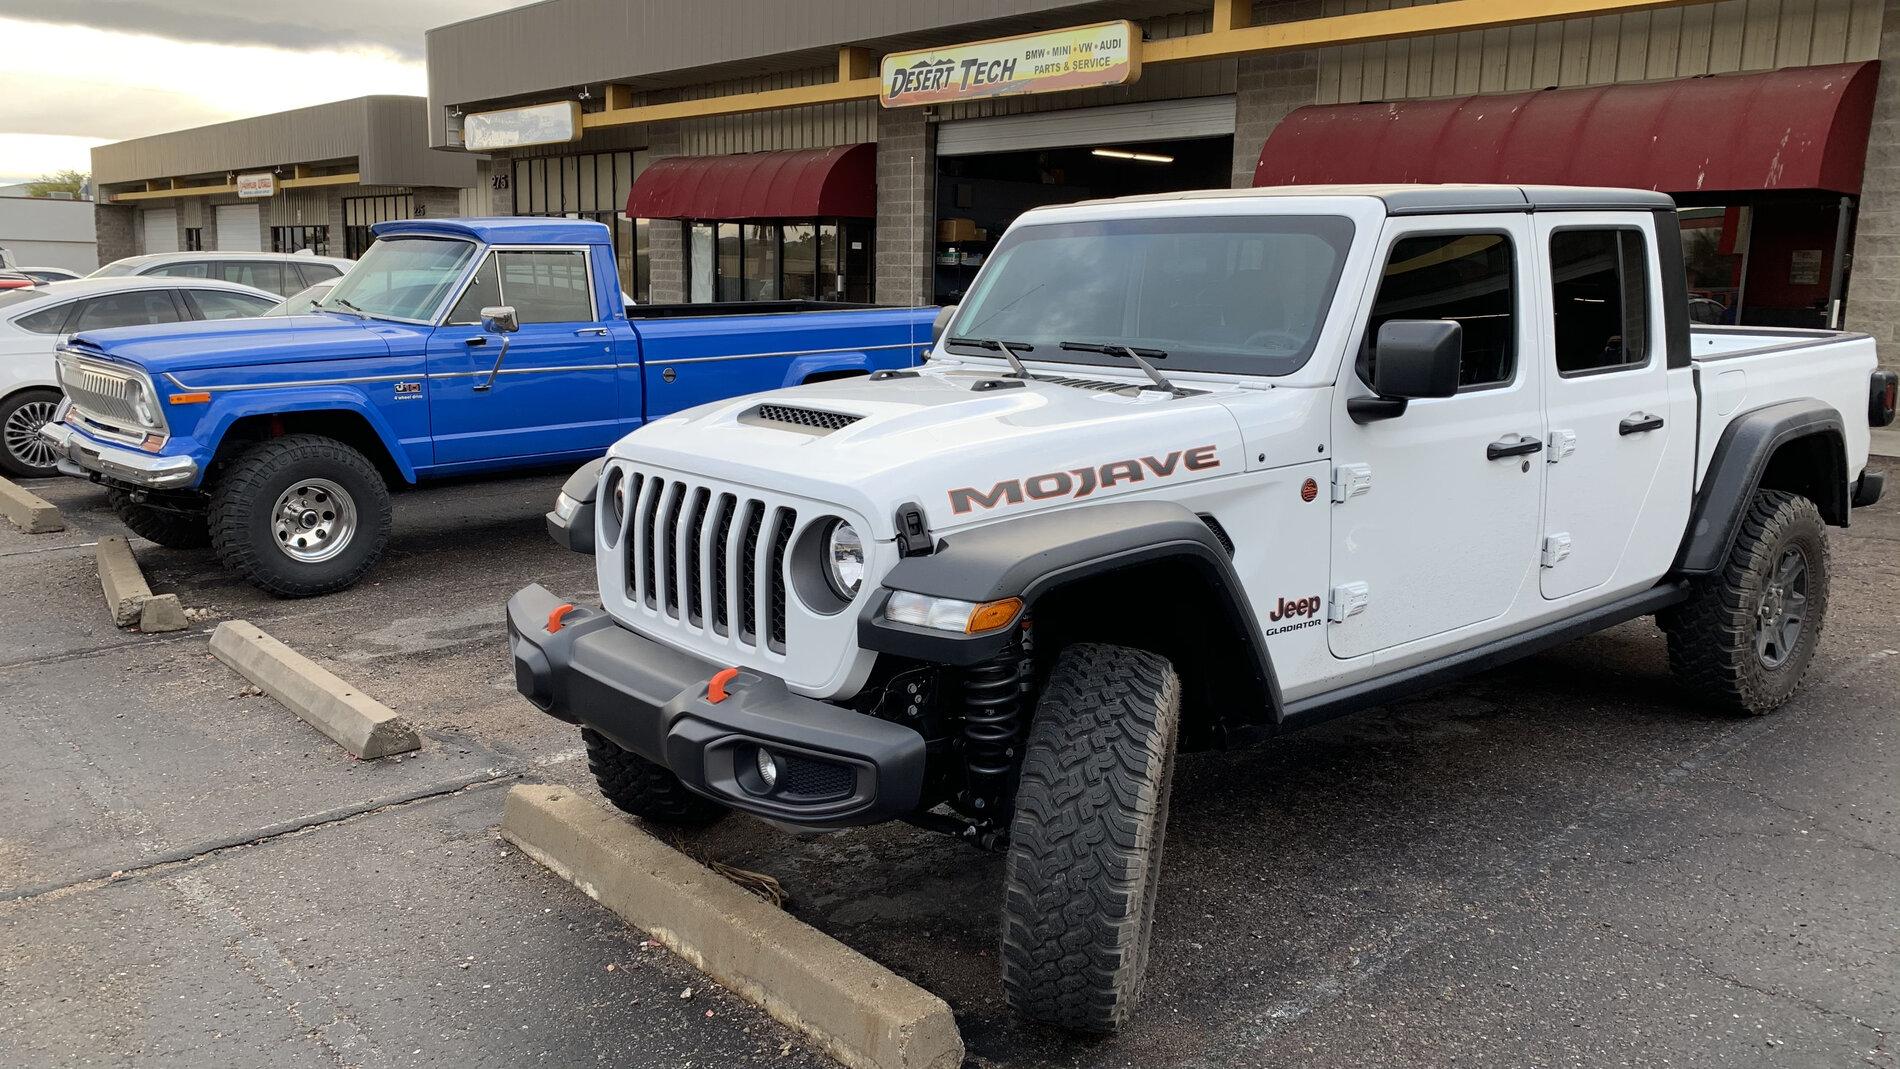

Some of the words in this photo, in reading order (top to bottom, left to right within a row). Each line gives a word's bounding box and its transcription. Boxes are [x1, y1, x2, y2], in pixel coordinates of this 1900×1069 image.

[1025, 48, 1046, 60] BMW
[1052, 45, 1072, 57] MINI
[1078, 42, 1093, 53] VW
[1099, 38, 1122, 50] AUDI
[1034, 61, 1061, 75] PARTS
[1063, 61, 1070, 72] &
[1072, 56, 1111, 70] SERVICE
[889, 66, 955, 99] DESERT
[960, 57, 1018, 92] TECH
[491, 175, 508, 189] 275
[947, 445, 1221, 515] MOJAVE
[1269, 595, 1321, 622] Jeep
[1266, 619, 1322, 636] GLADIATOR
